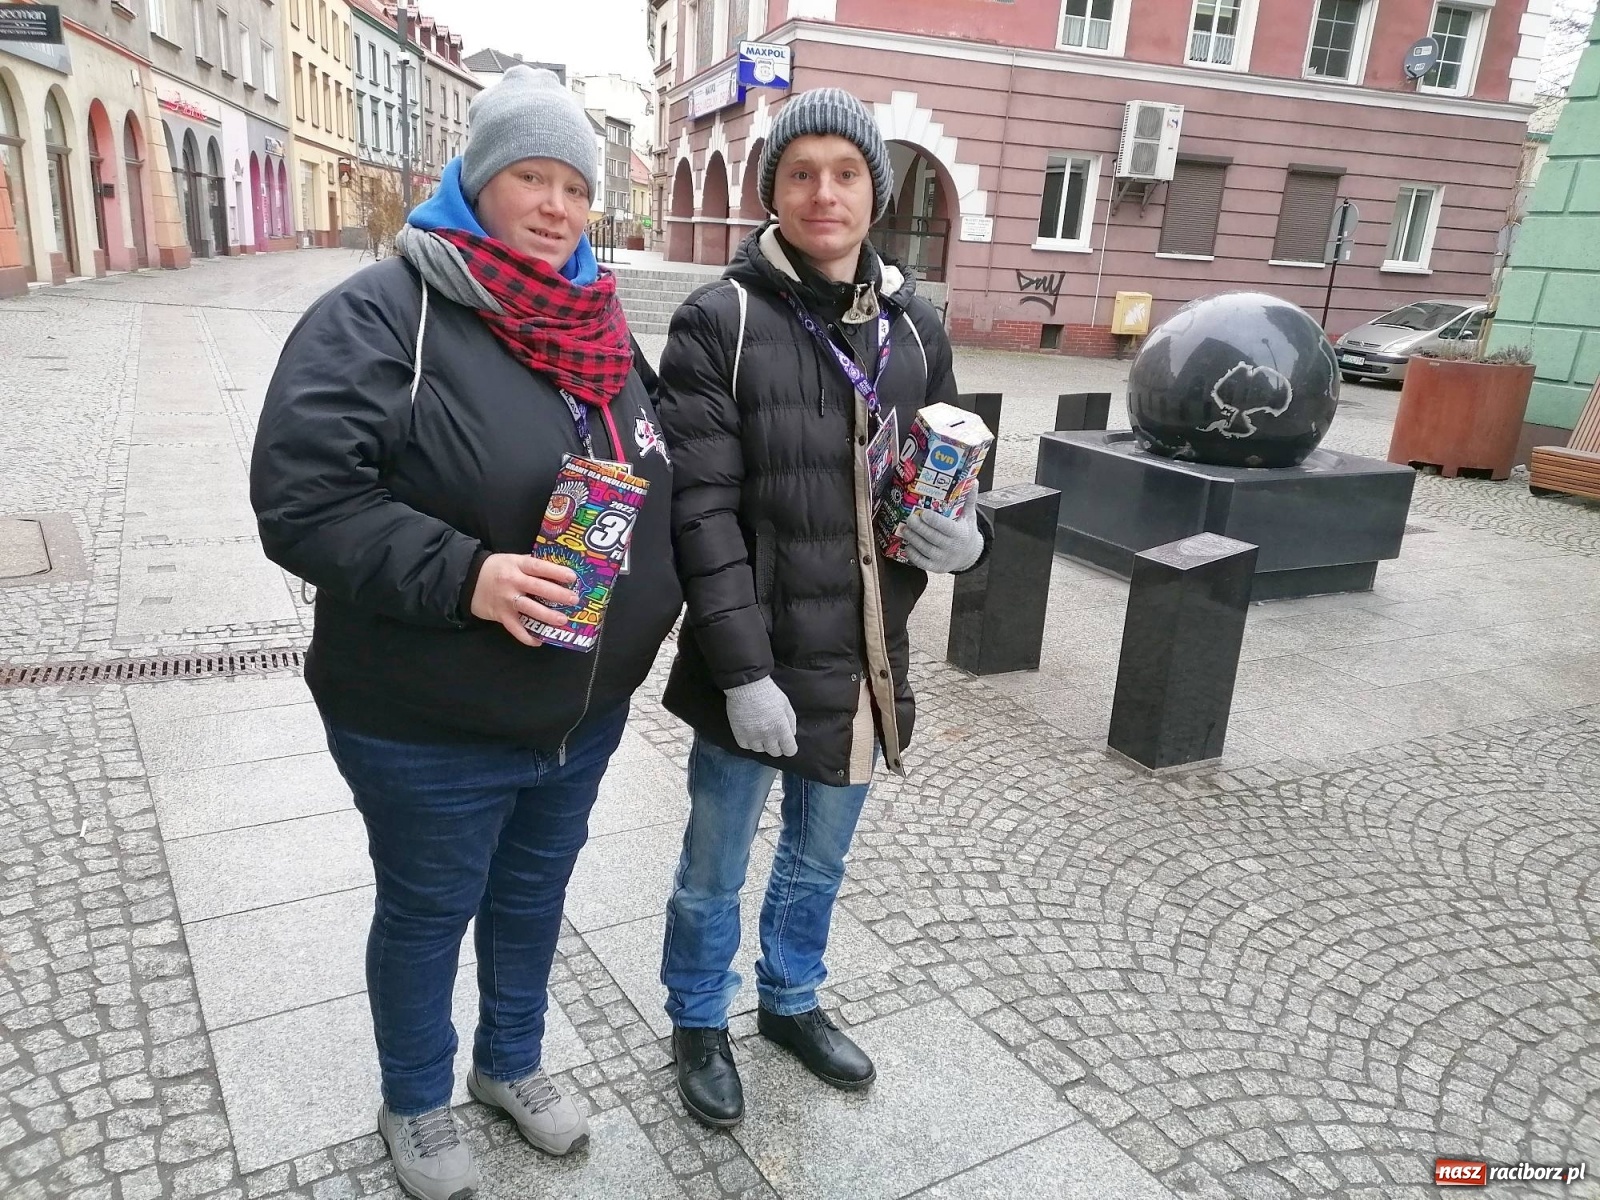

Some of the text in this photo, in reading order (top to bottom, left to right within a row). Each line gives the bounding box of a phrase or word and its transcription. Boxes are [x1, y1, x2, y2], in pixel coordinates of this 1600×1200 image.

[746, 46, 786, 59] MAXPOL
[934, 450, 955, 465] tvn
[565, 462, 589, 475] GRAMY
[588, 471, 600, 480] DLA
[609, 500, 636, 514] 2022
[519, 613, 576, 643] RZEJRZYJ
